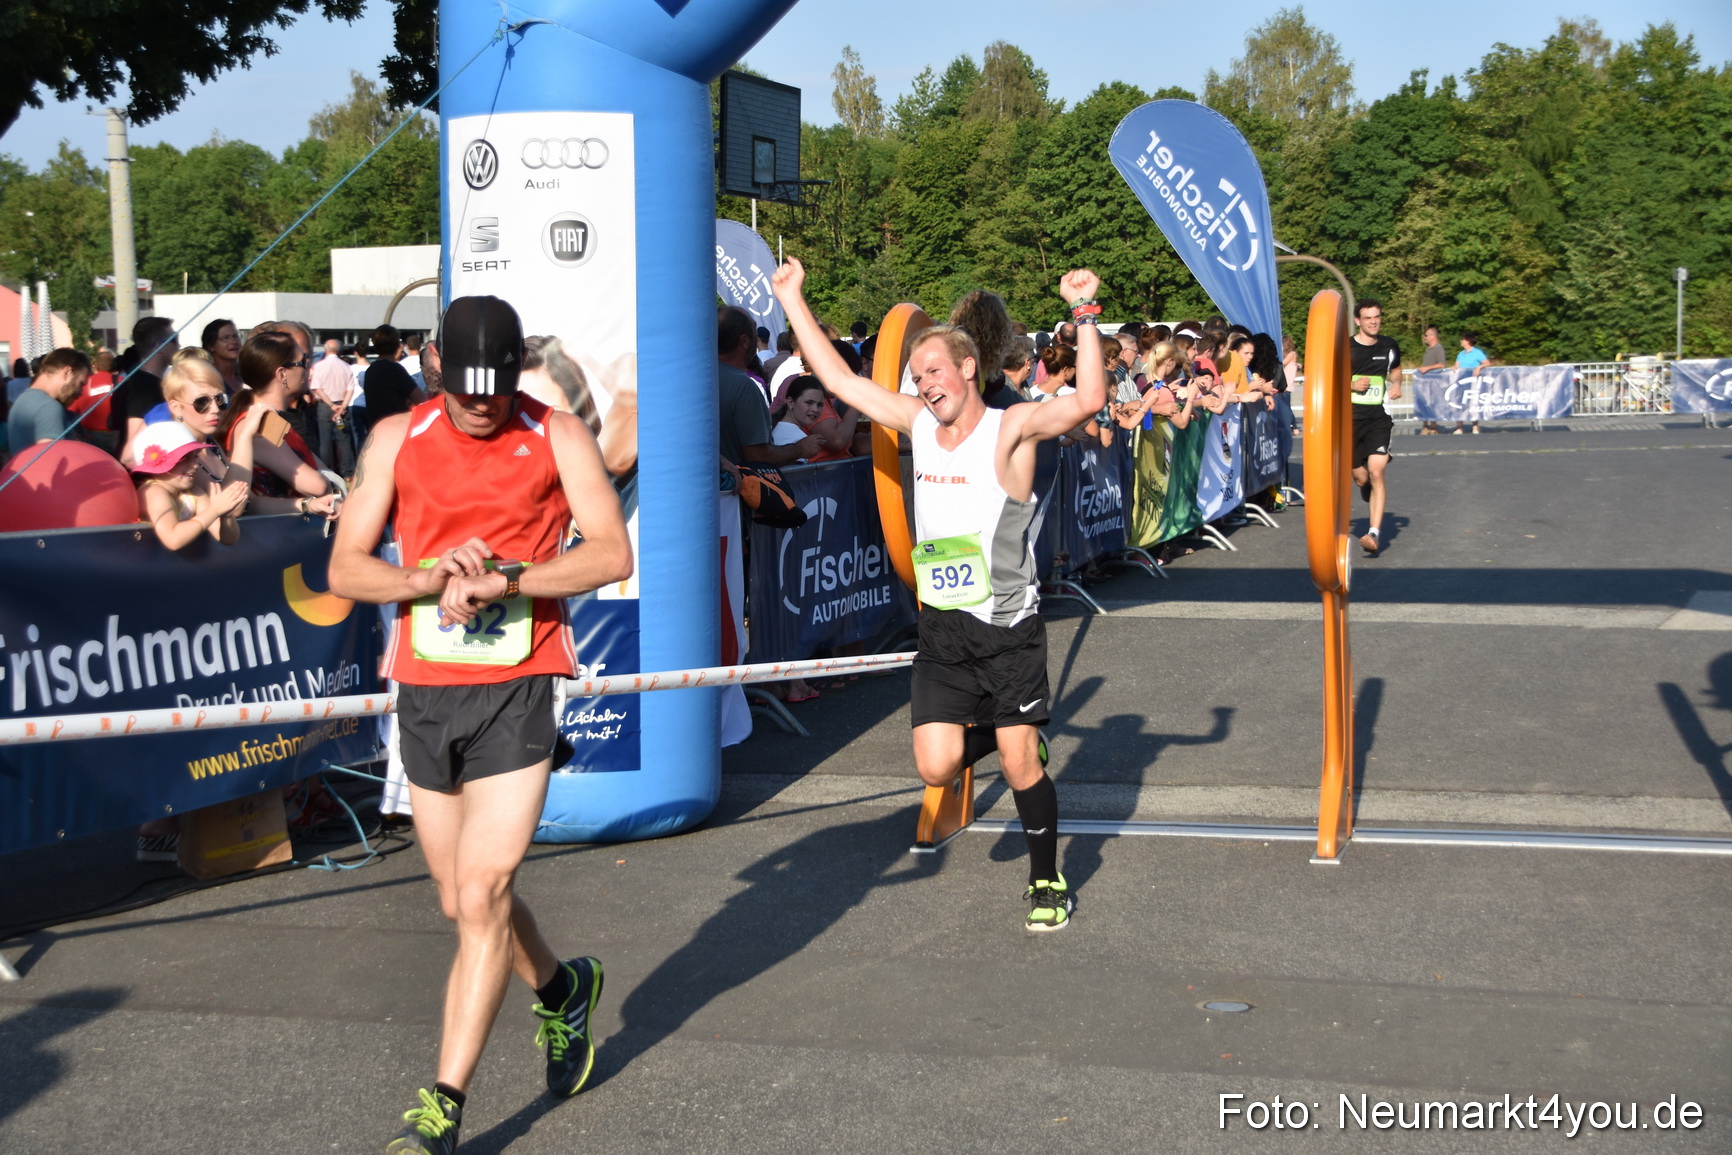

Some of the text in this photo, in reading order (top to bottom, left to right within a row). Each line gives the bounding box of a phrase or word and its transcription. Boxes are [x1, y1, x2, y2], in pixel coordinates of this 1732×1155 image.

[524, 178, 561, 190] Audi
[554, 228, 585, 252] FIAT
[462, 260, 511, 272] SEAT
[1461, 389, 1540, 404] Fischer
[1469, 404, 1533, 412] AUTOMOBILE
[924, 474, 970, 485] KLEBL
[931, 563, 975, 590] 592
[812, 585, 891, 625] AUTOMOBILE
[253, 671, 300, 704] und
[305, 660, 360, 699] Medien
[566, 708, 627, 726] Lächeln
[586, 725, 622, 739] mit!
